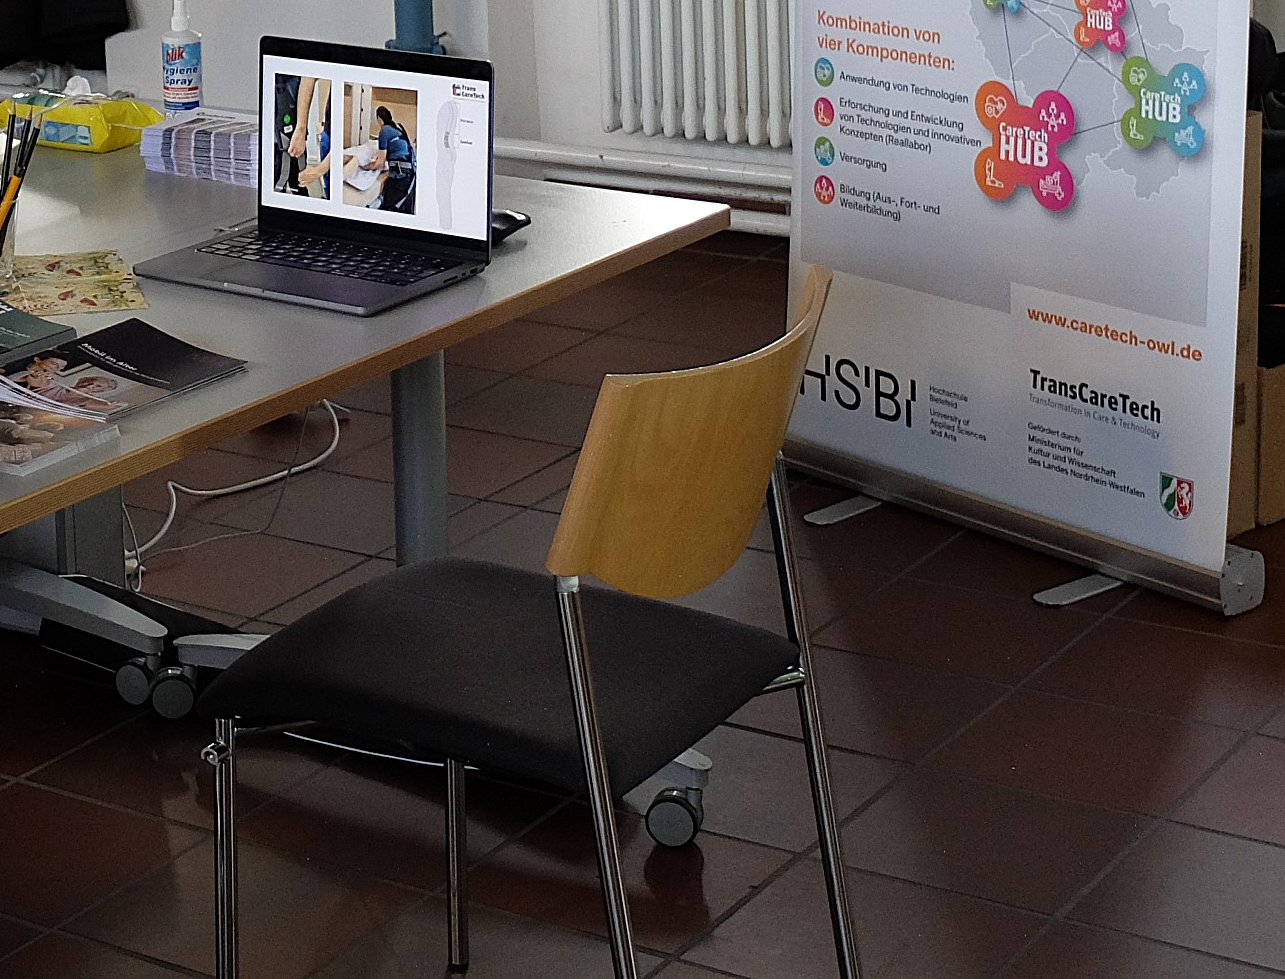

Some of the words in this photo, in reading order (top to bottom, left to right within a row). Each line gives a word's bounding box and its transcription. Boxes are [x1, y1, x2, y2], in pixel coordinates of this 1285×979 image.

[817, 10, 910, 39] Kombination
[914, 27, 941, 44] von
[1087, 13, 1113, 31] HUB
[817, 35, 843, 52] vier
[846, 38, 955, 71] Komponenten:
[165, 76, 193, 86] Spray
[839, 71, 891, 92] Anwendung
[892, 82, 909, 93] von
[910, 83, 969, 105] Technologien
[1140, 88, 1181, 104] CareTech
[839, 97, 890, 119] Erforschung
[892, 105, 909, 120] und
[910, 112, 964, 132] Entwicklung
[1141, 98, 1181, 123] HUB
[839, 113, 855, 124] von
[856, 116, 912, 137] Technologien
[913, 125, 930, 138] und
[930, 128, 982, 148] innovativen
[839, 125, 884, 145] Konzepten
[885, 133, 932, 154] (Reallabor)
[999, 122, 1049, 143] CareTech
[839, 151, 887, 172] Versorgung
[999, 137, 1049, 168] HUB
[839, 183, 871, 202] Bildung
[872, 190, 898, 207] (Aus-,
[899, 197, 922, 210] Fort-
[922, 201, 941, 216] und
[839, 196, 901, 222] Weiterbildung)
[81, 343, 107, 357] Mobil
[1027, 308, 1203, 362] www.caretech-owl.de
[1030, 368, 1161, 424] TransCareTech
[1029, 393, 1082, 416] Transformation
[1084, 408, 1091, 418] in
[1093, 411, 1109, 424] Care
[1119, 418, 1160, 440] Technology
[1028, 434, 1071, 453] Ministerium
[1073, 447, 1084, 457] für
[1028, 446, 1050, 459] Kultur
[1052, 453, 1066, 463] und
[1068, 457, 1116, 478] Wissenschaft
[1028, 457, 1041, 466] des
[1042, 460, 1068, 475] Landes
